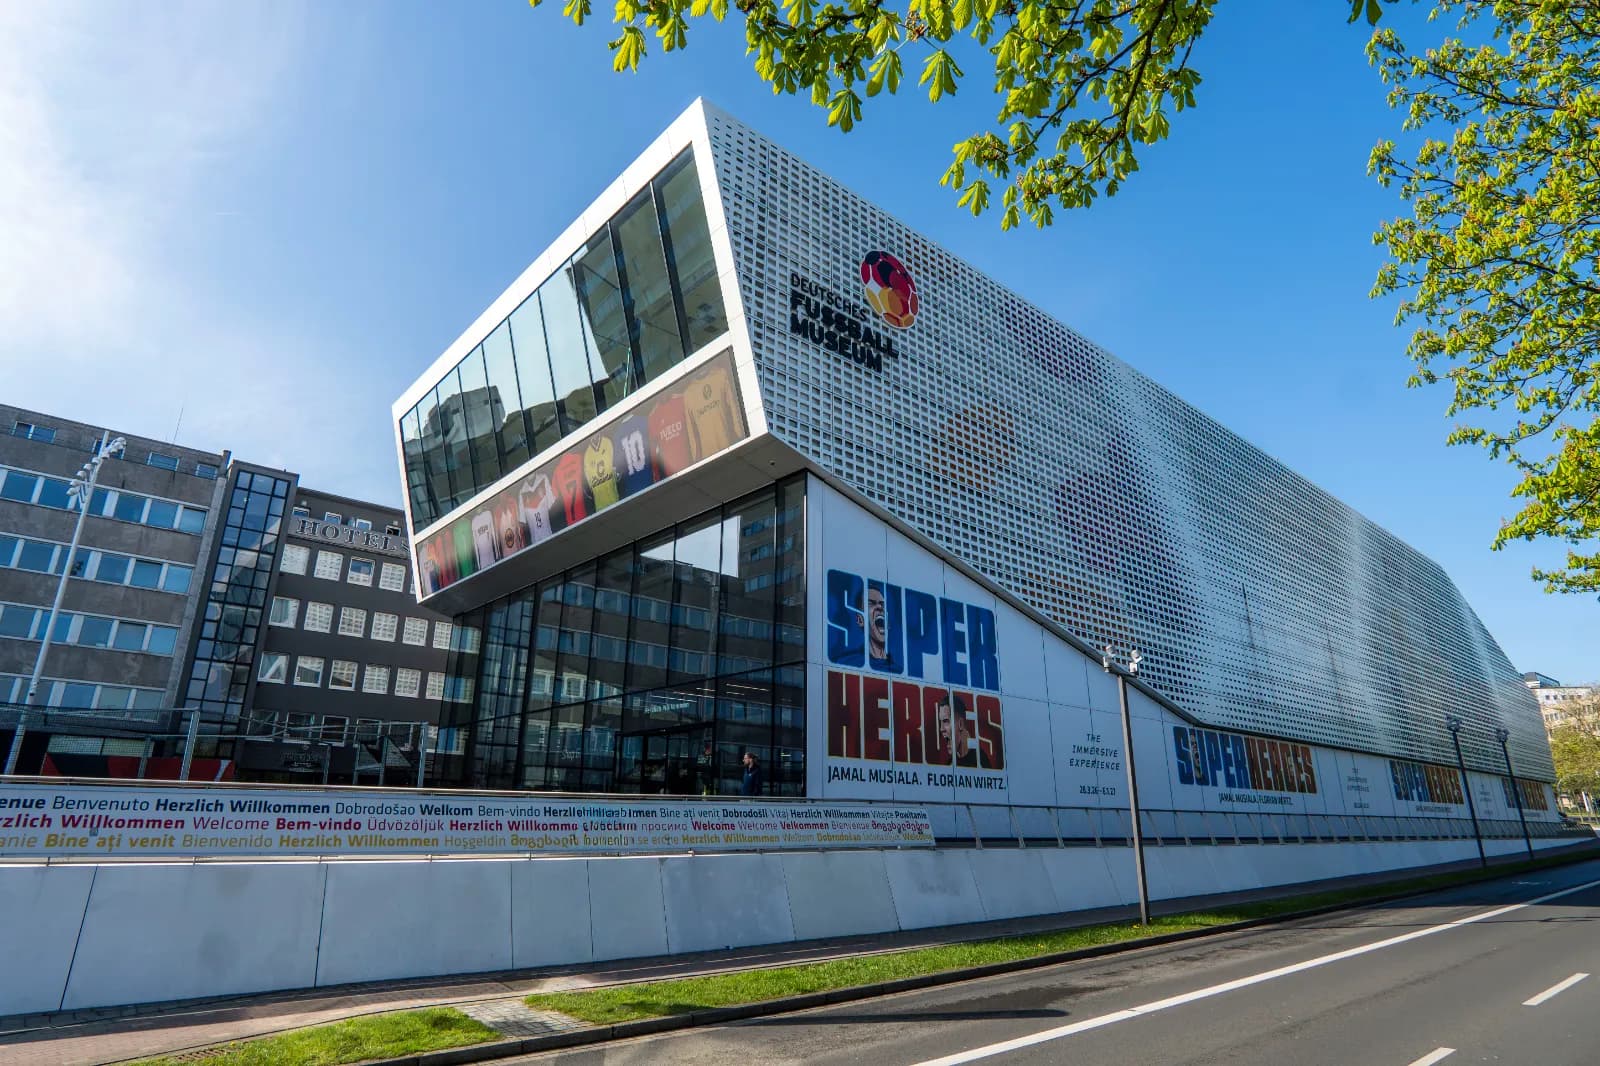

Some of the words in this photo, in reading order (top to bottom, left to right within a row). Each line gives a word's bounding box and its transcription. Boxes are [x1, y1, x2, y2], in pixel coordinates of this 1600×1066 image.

[791, 273, 867, 322] DEUTSCHES
[791, 289, 899, 359] FUSSBALL
[791, 313, 883, 373] MUSEUM
[621, 431, 646, 475] 10
[296, 519, 397, 552] HOTEL
[827, 568, 1000, 691] SUPER
[827, 670, 1004, 770] HEROES
[1087, 733, 1101, 743] THE
[1072, 744, 1119, 758] IMMERSIVE
[1069, 758, 1120, 770] EXPERIENCE
[828, 765, 866, 784] JAMAL
[869, 768, 922, 786] MUSIALA.
[928, 773, 972, 788] FLORIAN
[974, 775, 1007, 790] WIRTZ.
[52, 796, 150, 812] Benvenuto
[155, 798, 224, 813] Herzlich
[230, 799, 330, 815] Willkommen
[336, 802, 415, 815] Dobrodošao
[420, 804, 473, 816] Welkom
[478, 805, 540, 817] Bem-vindo
[660, 808, 681, 818] Bine
[698, 808, 719, 818] venit
[722, 808, 768, 818] Dobrodošli
[790, 809, 821, 818] Herzlich
[823, 809, 870, 819] Willkommen
[61, 814, 185, 830] Willkommen
[193, 816, 270, 830] Welcome
[276, 817, 361, 831] Bem-vindo
[367, 818, 444, 834] Üdvözöljük
[450, 819, 503, 831] Herzlich
[691, 820, 736, 831] Welcome
[738, 821, 778, 831] Welcome
[780, 821, 829, 830] Velkommen
[45, 833, 89, 848] Bine
[129, 834, 176, 848] venit
[182, 834, 273, 848] Bienvenido
[279, 834, 342, 848] Herzlich
[348, 834, 439, 848] Willkommen
